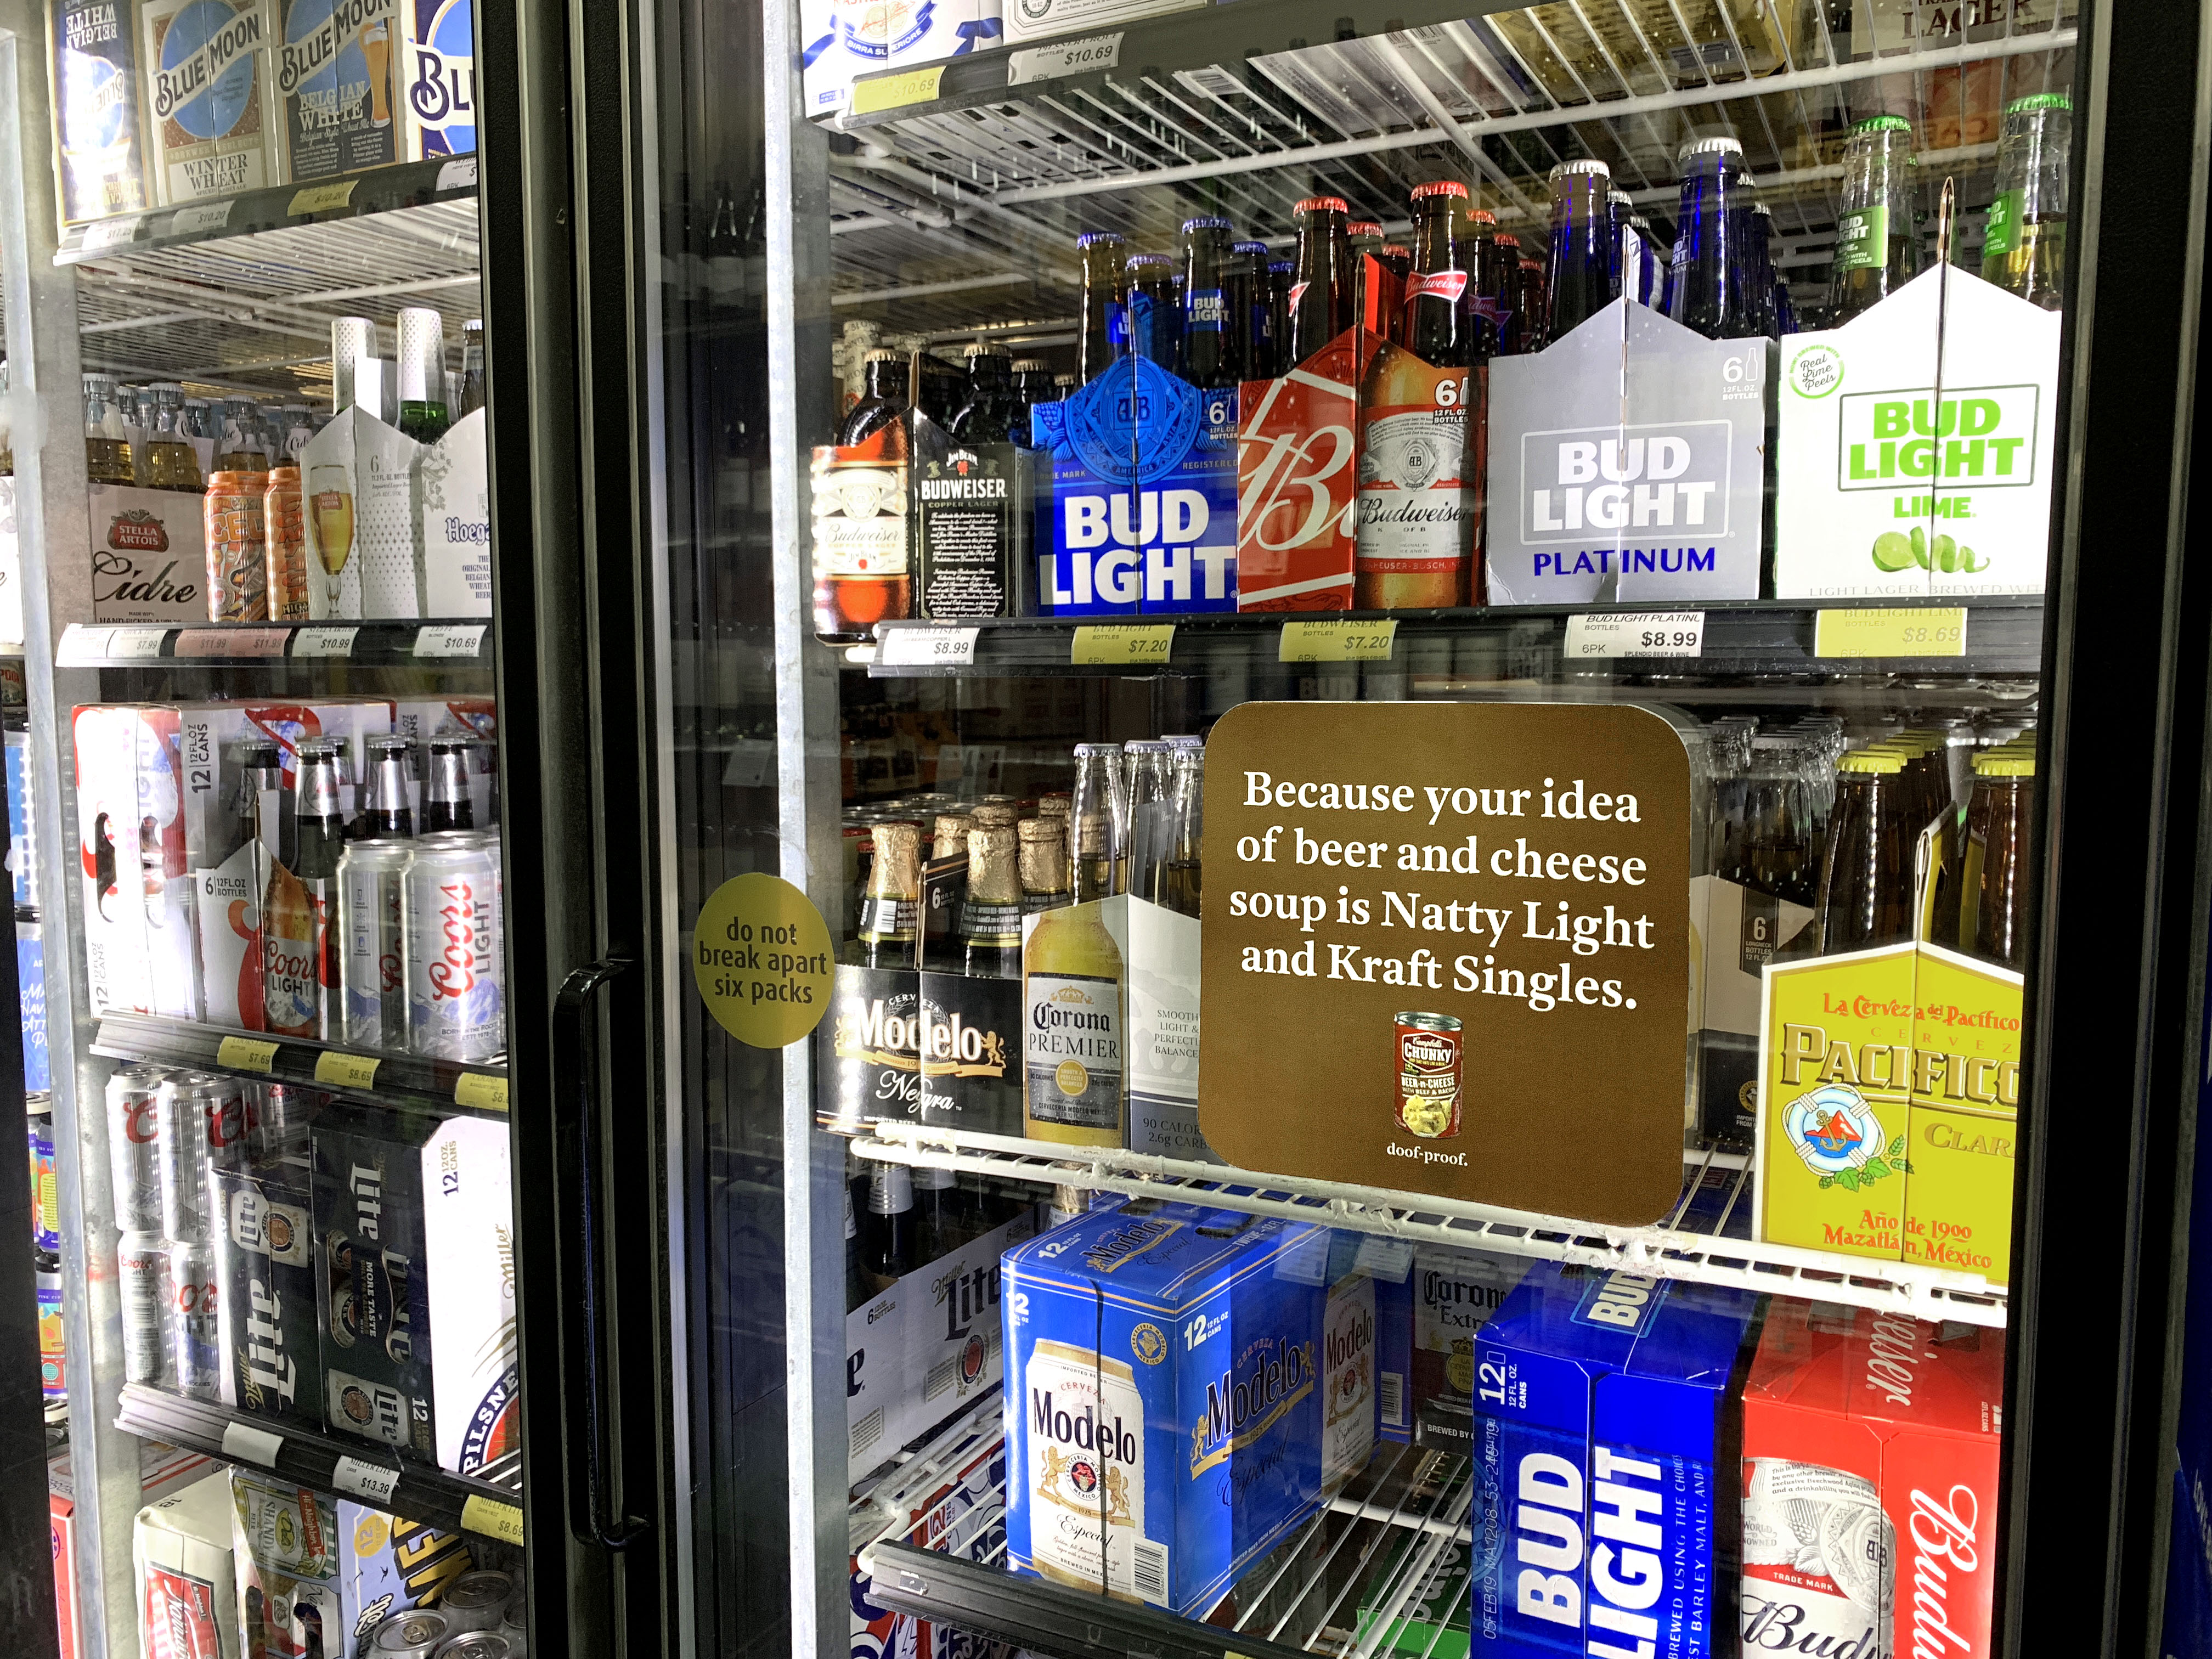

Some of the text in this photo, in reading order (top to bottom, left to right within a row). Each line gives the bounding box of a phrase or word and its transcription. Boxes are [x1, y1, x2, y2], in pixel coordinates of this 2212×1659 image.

[1902, 0, 2036, 40] LAGER
[279, 0, 391, 92] BLUE MOON
[847, 40, 873, 55] BIRRA
[1064, 45, 1113, 66] $10.69
[155, 14, 259, 117] BLUE MOON
[301, 81, 365, 110] BELGIAN
[893, 79, 934, 98] $10.69
[299, 101, 363, 131] WHITE
[183, 154, 248, 190] WINTER WHEAT
[1406, 274, 1465, 295] Budweiser
[1188, 308, 1229, 324] LIGHT
[1193, 296, 1225, 312] BUD
[1723, 356, 1743, 383] 6
[1799, 353, 1828, 373] Real
[1802, 364, 1833, 383] Lime
[1435, 379, 1458, 407] 6
[1804, 373, 1836, 391] Peels
[1722, 392, 1759, 401] BOTTLES
[1209, 401, 1226, 425] 6
[1434, 415, 1469, 424] BOTTLES
[1873, 398, 2002, 439] BUD
[1209, 432, 1238, 441] BOTTLES
[370, 454, 379, 473] 6
[1182, 459, 1239, 471] REGISTERED
[1558, 436, 1691, 485] BUD
[1849, 437, 2024, 480] LIGHT
[921, 479, 1008, 500] BUDWEISER
[967, 500, 998, 508] LAGER
[1359, 497, 1469, 524] Budweiser
[1533, 481, 1717, 533] LIGHT
[1893, 495, 1972, 519] LIME
[119, 524, 157, 537] STELLA
[1064, 488, 1209, 549] BUD
[119, 535, 159, 546] ARTOIS
[826, 524, 901, 544] Budweiser
[462, 565, 490, 573] ORIGINAL
[1533, 546, 1716, 577] PLATINUM
[93, 551, 198, 603] Cidre
[465, 573, 490, 582] BELGIAN
[469, 582, 490, 590] WHEAT
[1039, 545, 1236, 605] LIGHT
[137, 640, 157, 650] $7.99
[200, 639, 227, 649] $11.99
[253, 638, 283, 650] $11.99
[321, 637, 351, 649] $10.99
[444, 637, 477, 648] $10.69
[1128, 640, 1167, 653] $7.20
[1344, 636, 1390, 650] $7.20
[1641, 630, 1698, 649] $8.99
[1901, 627, 1961, 643] $8.69
[934, 642, 969, 655] $8.99
[1581, 644, 1606, 654] 6PK
[1840, 648, 1867, 658] 6PK
[198, 723, 209, 763] CANS
[191, 769, 211, 794] 12
[1243, 770, 1641, 825] Because your idea
[1236, 825, 1647, 886] of beer and cheese
[205, 876, 213, 895] 6
[217, 887, 247, 898] BOTTLES
[932, 887, 941, 910] 6
[726, 916, 798, 946] do not
[1229, 885, 1656, 956] soup is Natty Light
[1753, 916, 1767, 941] 6
[429, 882, 473, 1001] Coors
[475, 900, 490, 975] LIGHT
[267, 940, 318, 982] Coors
[699, 936, 828, 978] break apart
[1745, 946, 1773, 956] BOTTLES
[714, 972, 813, 1006] six packs
[1240, 940, 1639, 1013] and Kraft Singles.
[97, 986, 108, 1007] 12
[1032, 1002, 1110, 1034] Corona
[1156, 1009, 1199, 1022] SMOOTH
[1823, 992, 2021, 1031] La Cerveza del Pacífico
[854, 997, 983, 1060] Modelo
[1159, 1021, 1199, 1032] LIGHT &
[1029, 1031, 1120, 1060] PREMIER
[1404, 1041, 1452, 1064] CHUNKY
[248, 1052, 270, 1065] $7.69
[348, 1069, 372, 1081] $8.69
[876, 1070, 955, 1119] Negra
[449, 1139, 458, 1171] CANS
[1386, 1142, 1469, 1167] doof-proof.
[443, 1171, 459, 1197] 12
[349, 1161, 382, 1241] Lite
[239, 1195, 257, 1248] Lite
[1859, 1209, 1972, 1244] Año de 1900
[1038, 1242, 1069, 1260] 12
[1081, 1220, 1166, 1265] Modelo
[1925, 1238, 1993, 1269] México
[365, 1261, 377, 1338] MORE TASTE
[945, 1263, 1002, 1341] Lite
[867, 1307, 874, 1325] 6
[246, 1278, 296, 1406] Lite
[1183, 1314, 1207, 1352] 12
[1325, 1308, 1373, 1376] Modelo
[1205, 1335, 1301, 1450] Modelo
[1479, 1362, 1505, 1406] 12
[1519, 1381, 1527, 1409] CANS
[374, 1388, 398, 1441] Lite
[413, 1396, 428, 1421] 12
[1032, 1386, 1136, 1466] Modelo
[1427, 1424, 1470, 1440] BREWED BY
[360, 1477, 390, 1495] $13.39
[1771, 1477, 1861, 1491] exclusive Beechwood Aging
[1056, 1513, 1114, 1551] Especial
[1517, 1452, 1584, 1629] BUD
[1587, 1445, 1663, 1659] LIGHT
[1690, 1471, 1708, 1633] BARLEY MALT, AND
[1668, 1497, 1686, 1659] BREWED USING THE
[1773, 1572, 1834, 1592] TRADE MARK
